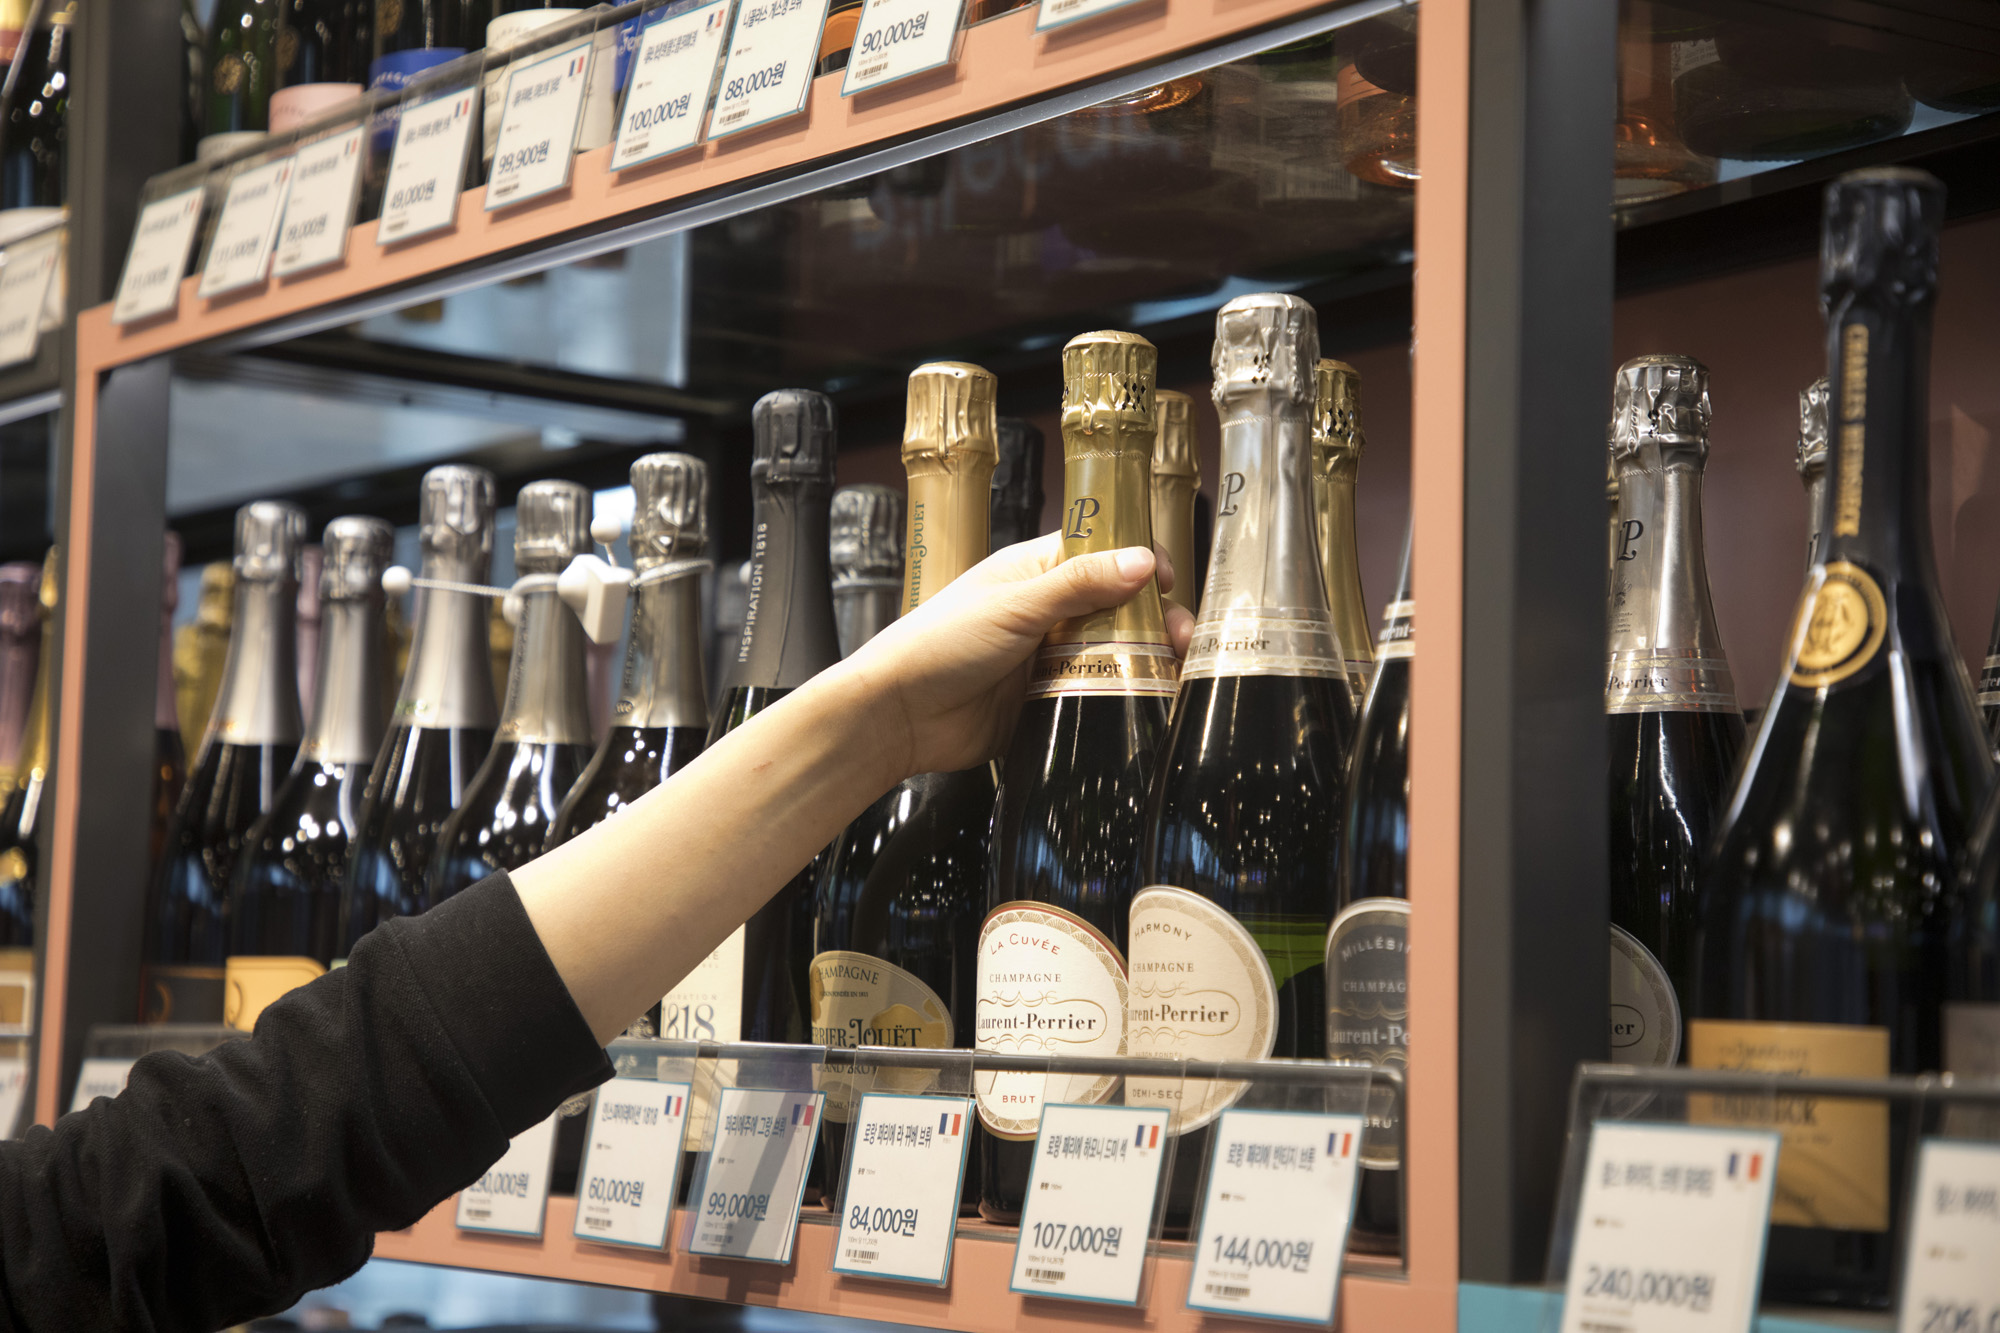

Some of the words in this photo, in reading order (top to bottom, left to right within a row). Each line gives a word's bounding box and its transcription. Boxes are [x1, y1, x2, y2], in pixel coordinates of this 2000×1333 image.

[861, 10, 929, 55] 90,000원
[725, 60, 786, 101] 88,000원
[629, 93, 691, 133] 100,000원
[498, 139, 550, 175] 99,900원
[908, 500, 928, 612] RRIER-JOUËT
[738, 563, 764, 663] INSPIRATION
[755, 522, 768, 558] 1818
[1134, 923, 1192, 941] HARMONY
[990, 973, 1061, 983] CHAMPAGNE
[1133, 962, 1194, 973] CHAMPAGNE
[977, 1012, 1096, 1030] Laurent-Perrier
[1002, 1095, 1036, 1103] BRUT
[1132, 1088, 1183, 1100] DEMI-SEC
[643, 1106, 658, 1126] 1818
[758, 1116, 773, 1138] 그랑
[772, 1117, 787, 1139] 브뤼
[863, 1123, 877, 1145] 로랑
[876, 1122, 896, 1146] 페리에
[896, 1124, 905, 1147] 라
[918, 1126, 933, 1149] 브뤼
[1047, 1135, 1062, 1158] 로랑
[1062, 1136, 1083, 1160] 페리에
[1084, 1137, 1105, 1161] 하모니
[1104, 1138, 1119, 1162] 드미
[1227, 1143, 1245, 1168] 로랑
[1246, 1144, 1272, 1170] 페리에
[589, 1177, 643, 1207] 60,000원
[707, 1192, 770, 1221] 99,000원
[850, 1205, 918, 1237] 84,000원
[1033, 1222, 1122, 1257] 107,000원
[1214, 1236, 1313, 1273] 144,000원
[1584, 1266, 1716, 1313] 240,000원
